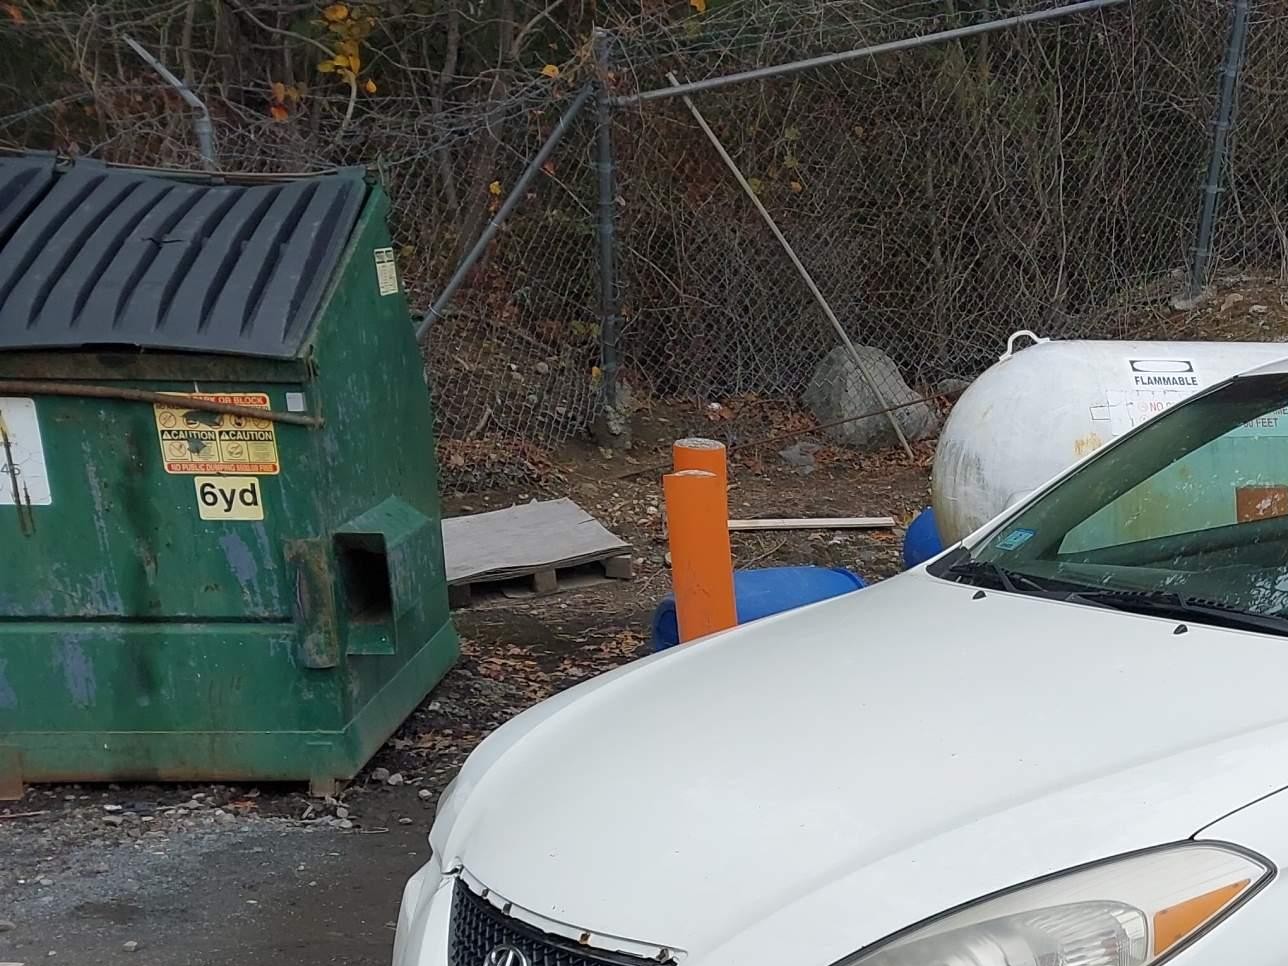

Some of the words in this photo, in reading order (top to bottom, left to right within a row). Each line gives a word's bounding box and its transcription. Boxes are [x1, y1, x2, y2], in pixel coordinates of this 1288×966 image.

[1134, 375, 1199, 386] FLAMMABLE
[218, 396, 232, 404] OR
[233, 396, 264, 405] BLOCK
[1150, 402, 1164, 412] NO
[1256, 418, 1279, 428] FEET
[228, 430, 272, 441] CAUTION
[170, 463, 180, 472] NO
[181, 463, 206, 472] PUBLIC
[206, 463, 236, 472] DUMPING
[200, 482, 259, 513] 6yd
